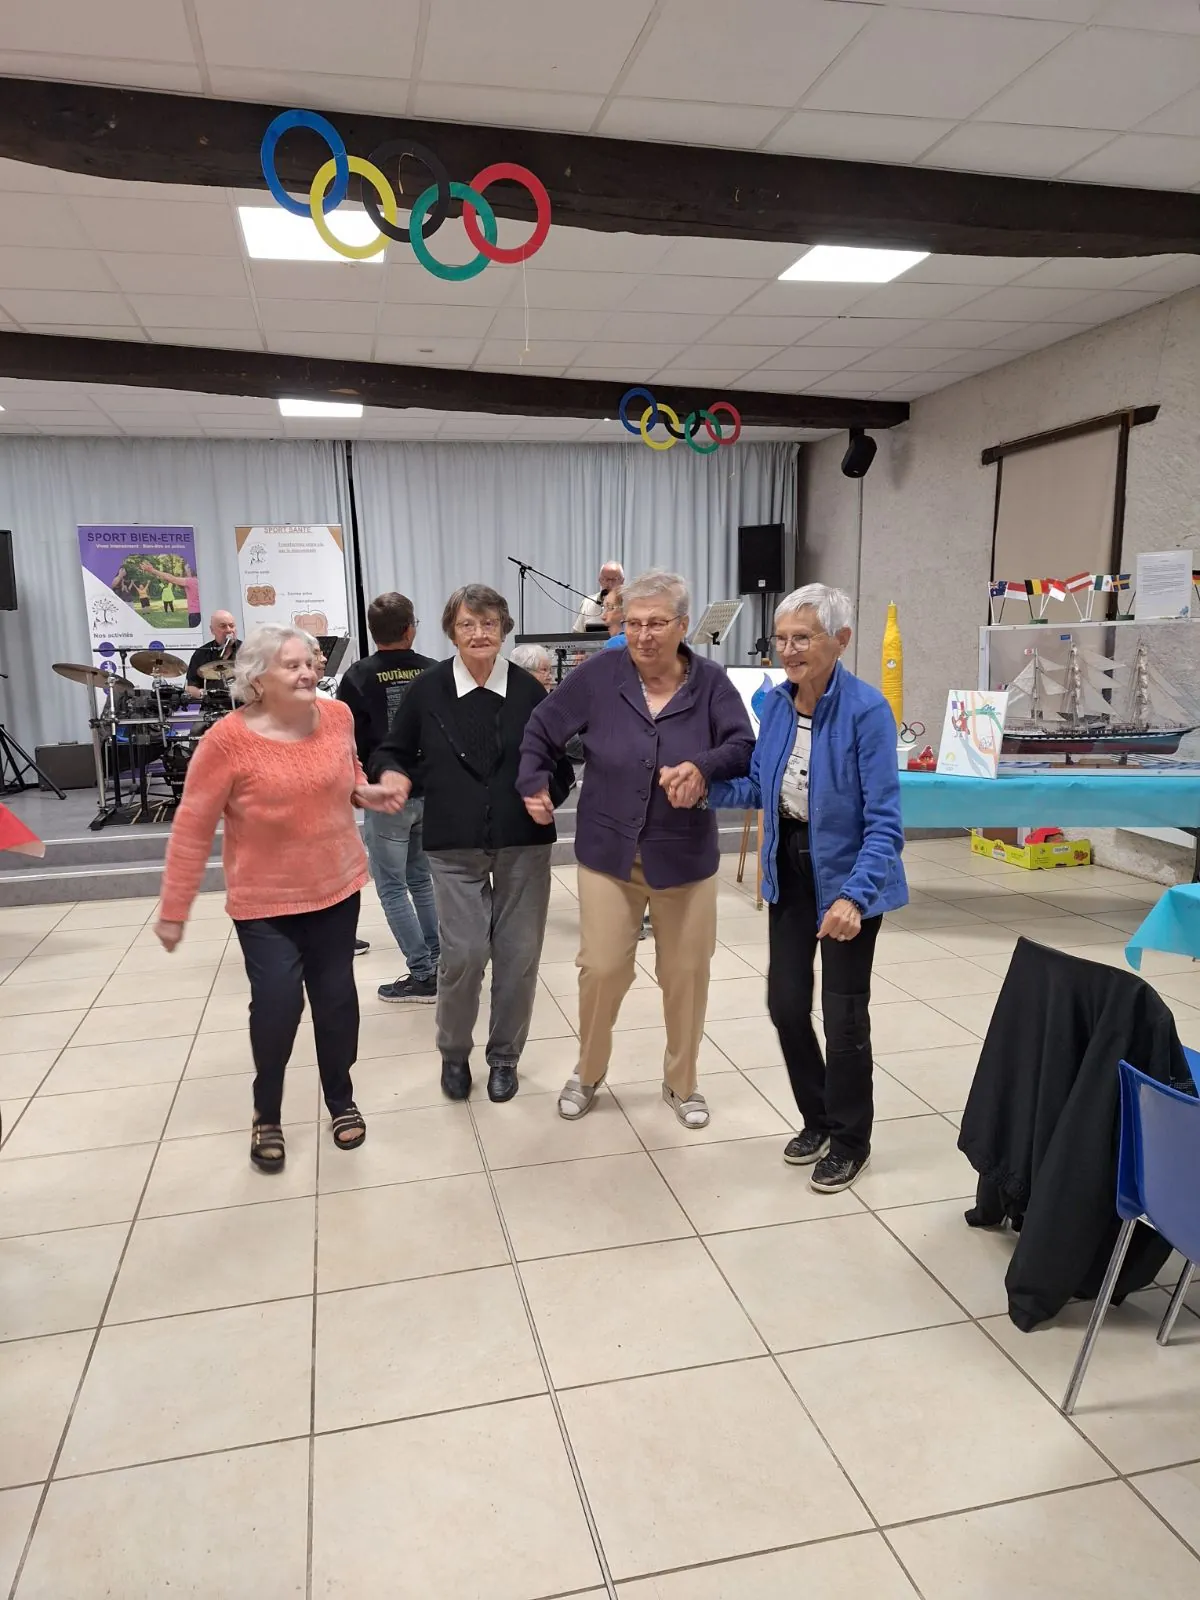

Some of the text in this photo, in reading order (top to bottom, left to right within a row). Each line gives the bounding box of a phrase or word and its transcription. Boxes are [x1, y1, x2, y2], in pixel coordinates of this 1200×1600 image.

[264, 526, 288, 534] SPORT
[87, 532, 192, 543] SPORT BIEN-ETRE
